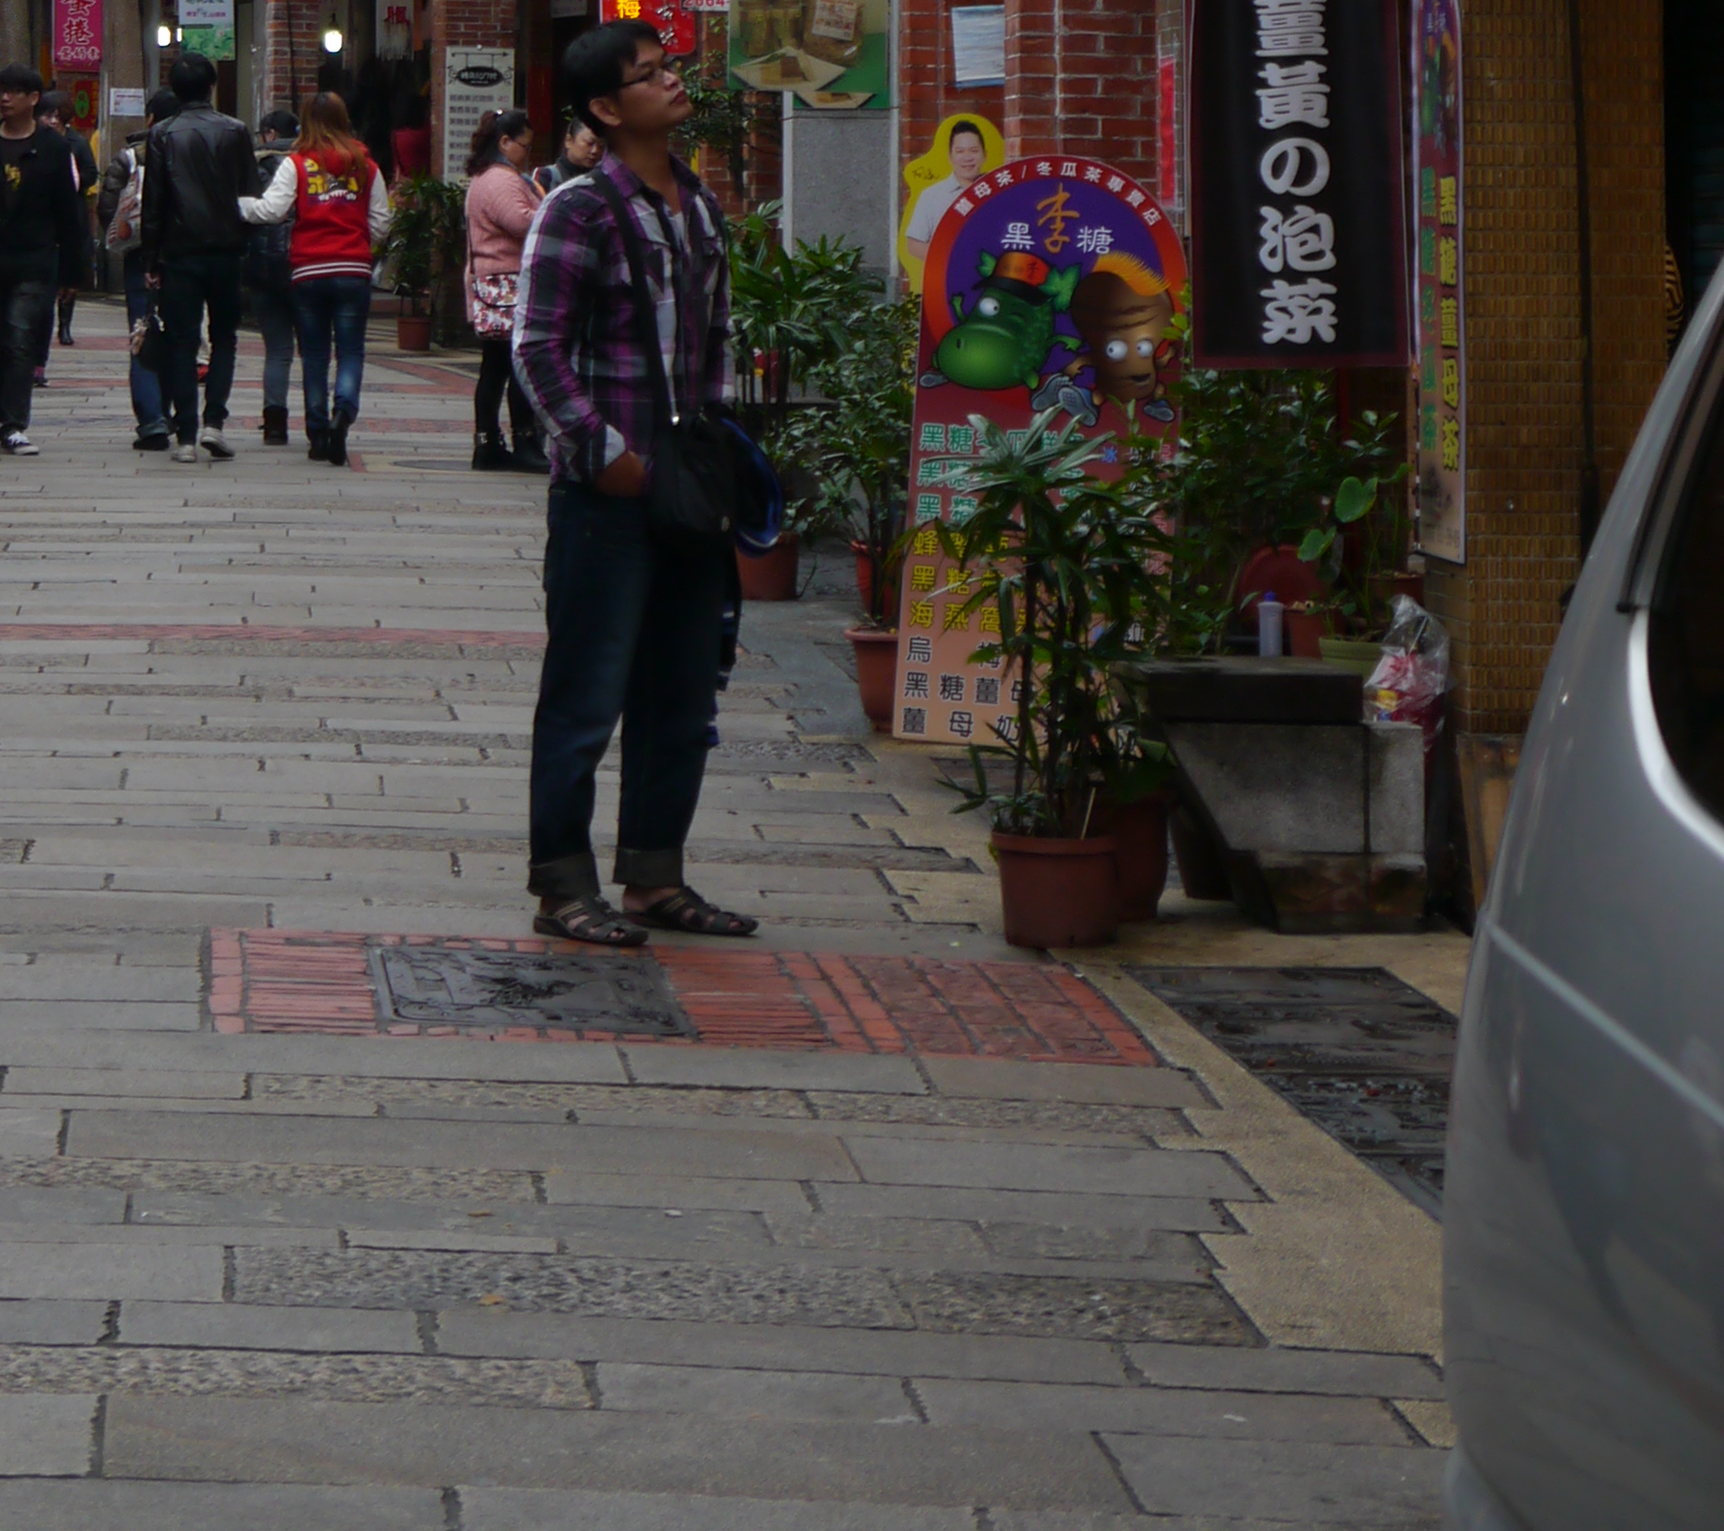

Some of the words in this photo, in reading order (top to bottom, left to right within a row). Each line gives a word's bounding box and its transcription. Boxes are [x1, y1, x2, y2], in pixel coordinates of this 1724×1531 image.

[1035, 181, 1081, 254] 李
[1439, 172, 1460, 473] 黑糖薑母茶
